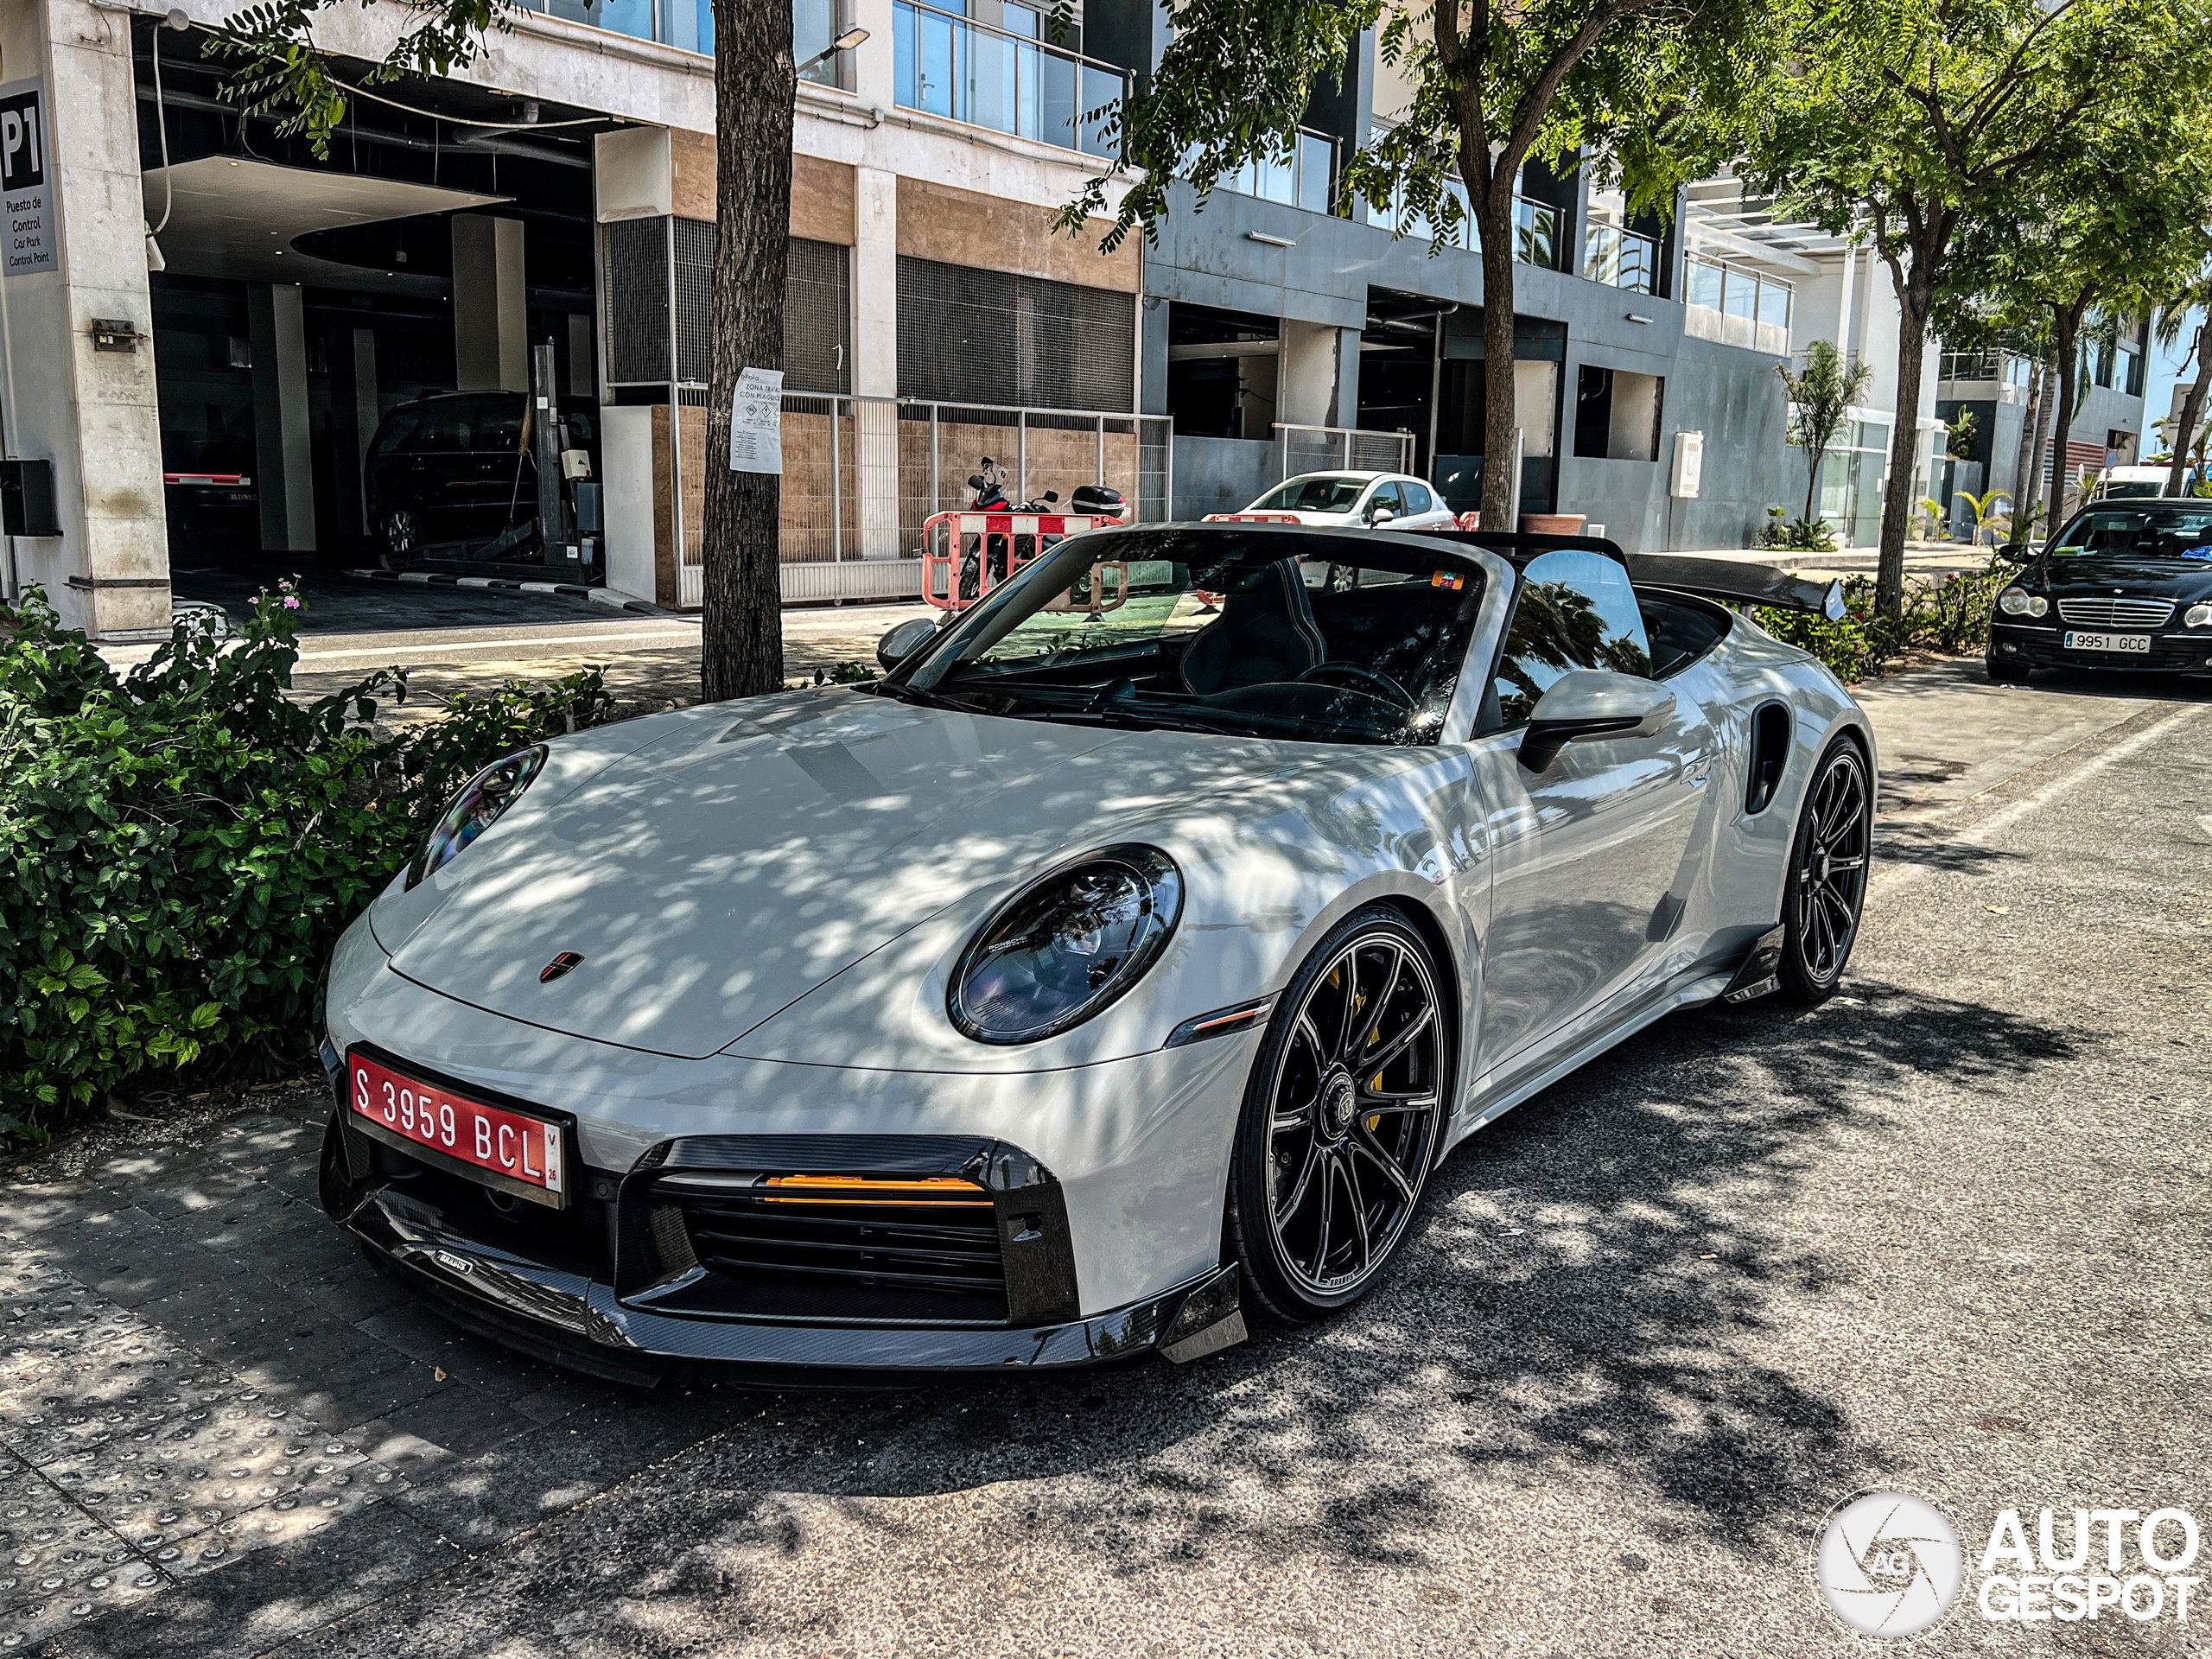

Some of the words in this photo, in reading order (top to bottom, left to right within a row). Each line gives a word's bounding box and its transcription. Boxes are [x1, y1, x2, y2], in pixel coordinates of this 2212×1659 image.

[1, 105, 39, 177] P1
[6, 200, 31, 213] Puesto
[32, 196, 41, 209] de
[12, 216, 41, 232] Control
[14, 238, 26, 250] Car
[26, 235, 41, 247] Park
[10, 252, 33, 267] Control
[33, 251, 49, 264] Point
[740, 391, 755, 399] CON
[746, 383, 764, 391] ZONA
[2076, 635, 2109, 649] 9951
[2119, 636, 2146, 651] GCC
[356, 1068, 369, 1109] S
[382, 1081, 456, 1147] 3959
[474, 1115, 541, 1178] BCL
[548, 1167, 557, 1181] 26
